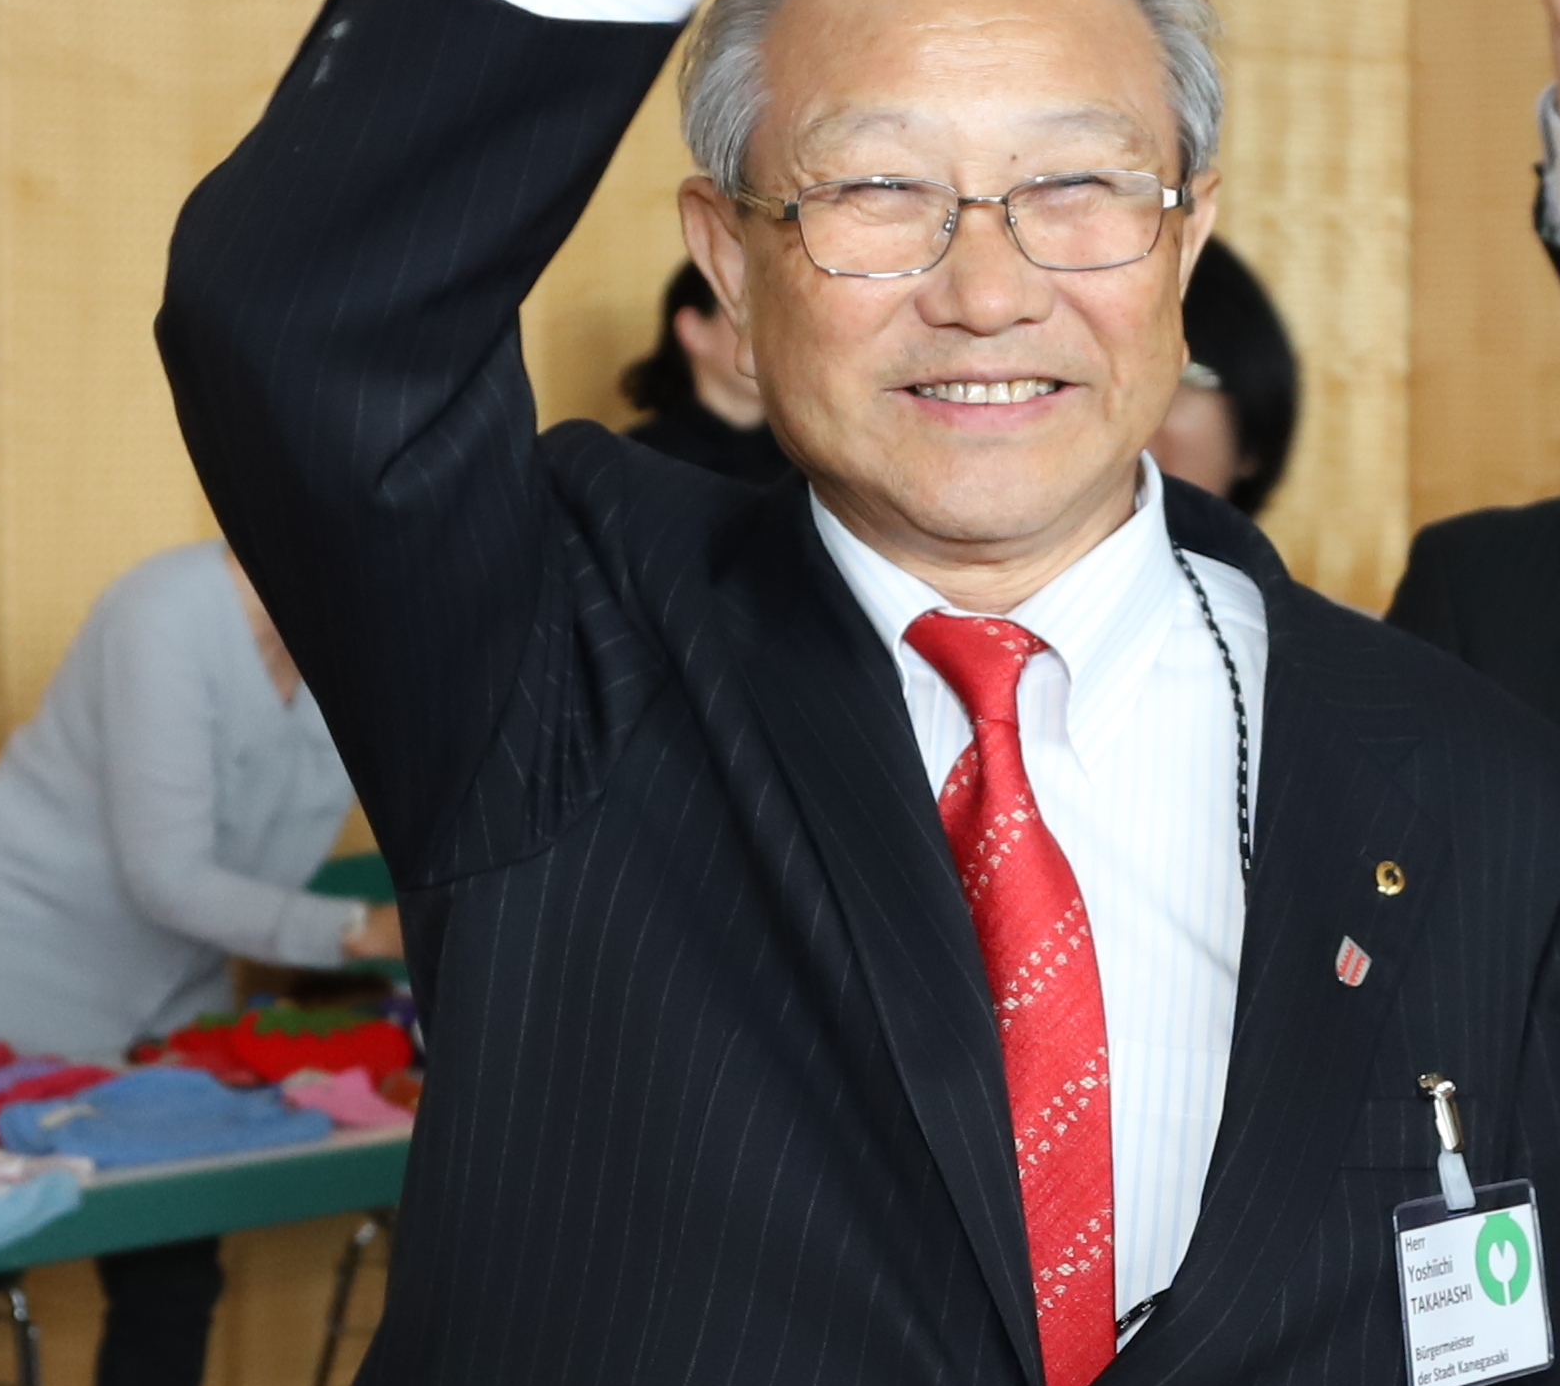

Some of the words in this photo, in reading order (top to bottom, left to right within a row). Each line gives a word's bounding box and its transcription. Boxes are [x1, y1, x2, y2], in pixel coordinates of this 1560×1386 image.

[1405, 1236, 1426, 1252] Herr
[1407, 1254, 1454, 1283] Yoshiichi
[1410, 1283, 1473, 1315] TAKAHASHI
[1415, 1336, 1475, 1361] Bürgermeister
[1417, 1371, 1432, 1386] der
[1433, 1363, 1457, 1382] Stadt
[1457, 1348, 1509, 1372] Kanegasaki
